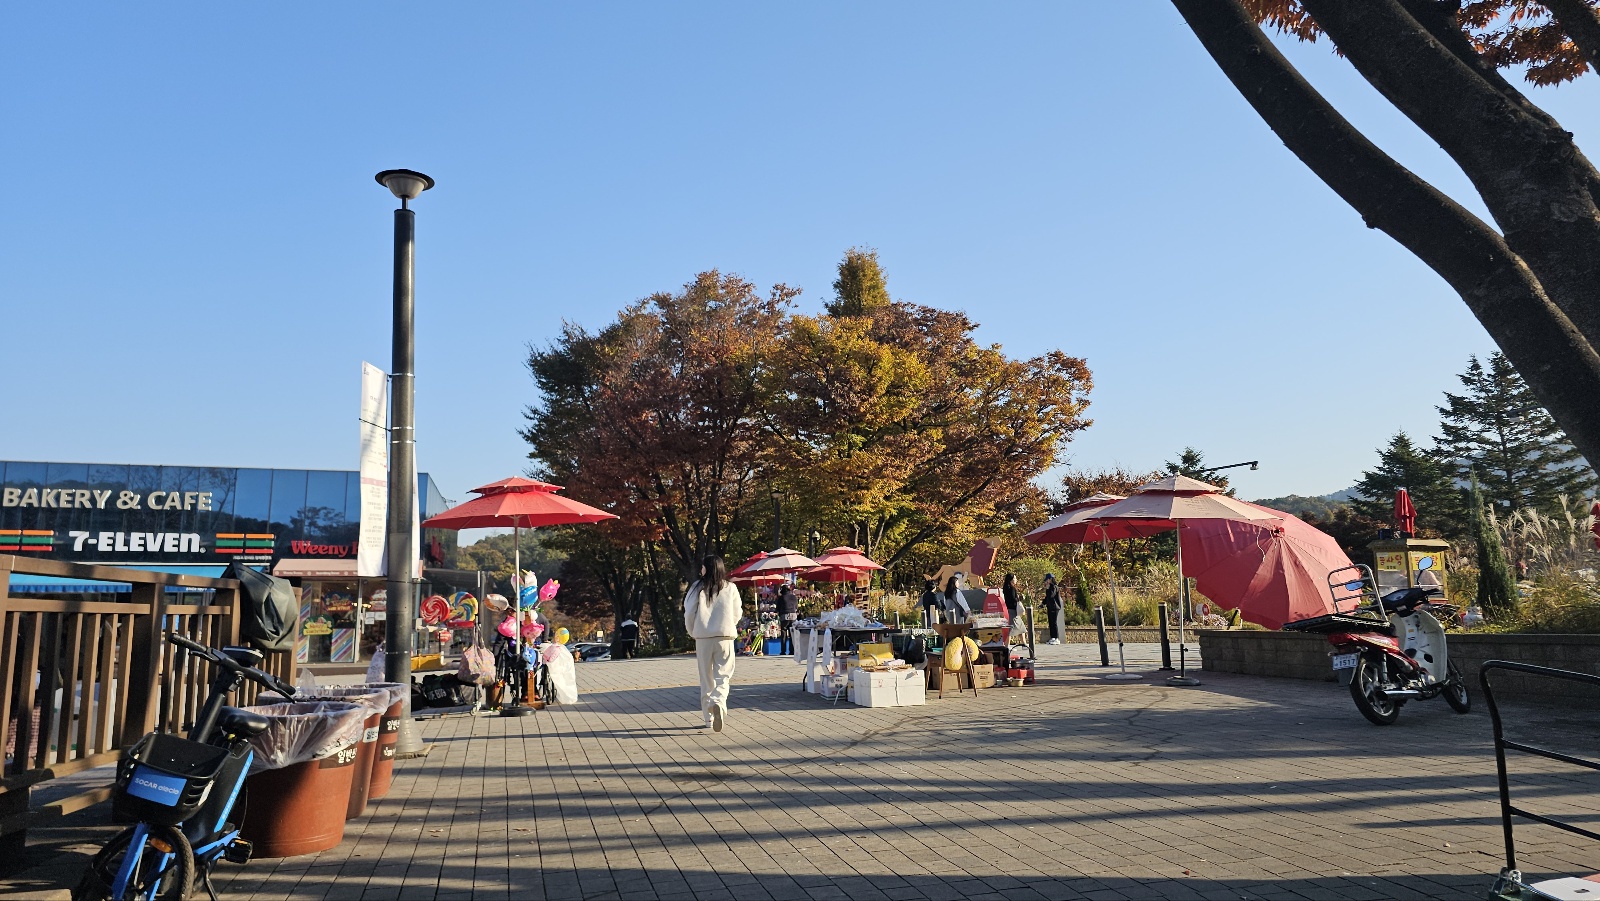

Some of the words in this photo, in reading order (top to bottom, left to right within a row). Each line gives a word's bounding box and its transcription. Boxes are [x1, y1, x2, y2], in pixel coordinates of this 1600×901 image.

[2, 487, 112, 509] BAKERY
[116, 490, 141, 509] &
[147, 491, 213, 511] CAFE
[291, 540, 349, 558] Weeny
[1339, 658, 1356, 667] 1517
[134, 777, 158, 790] SOCAR
